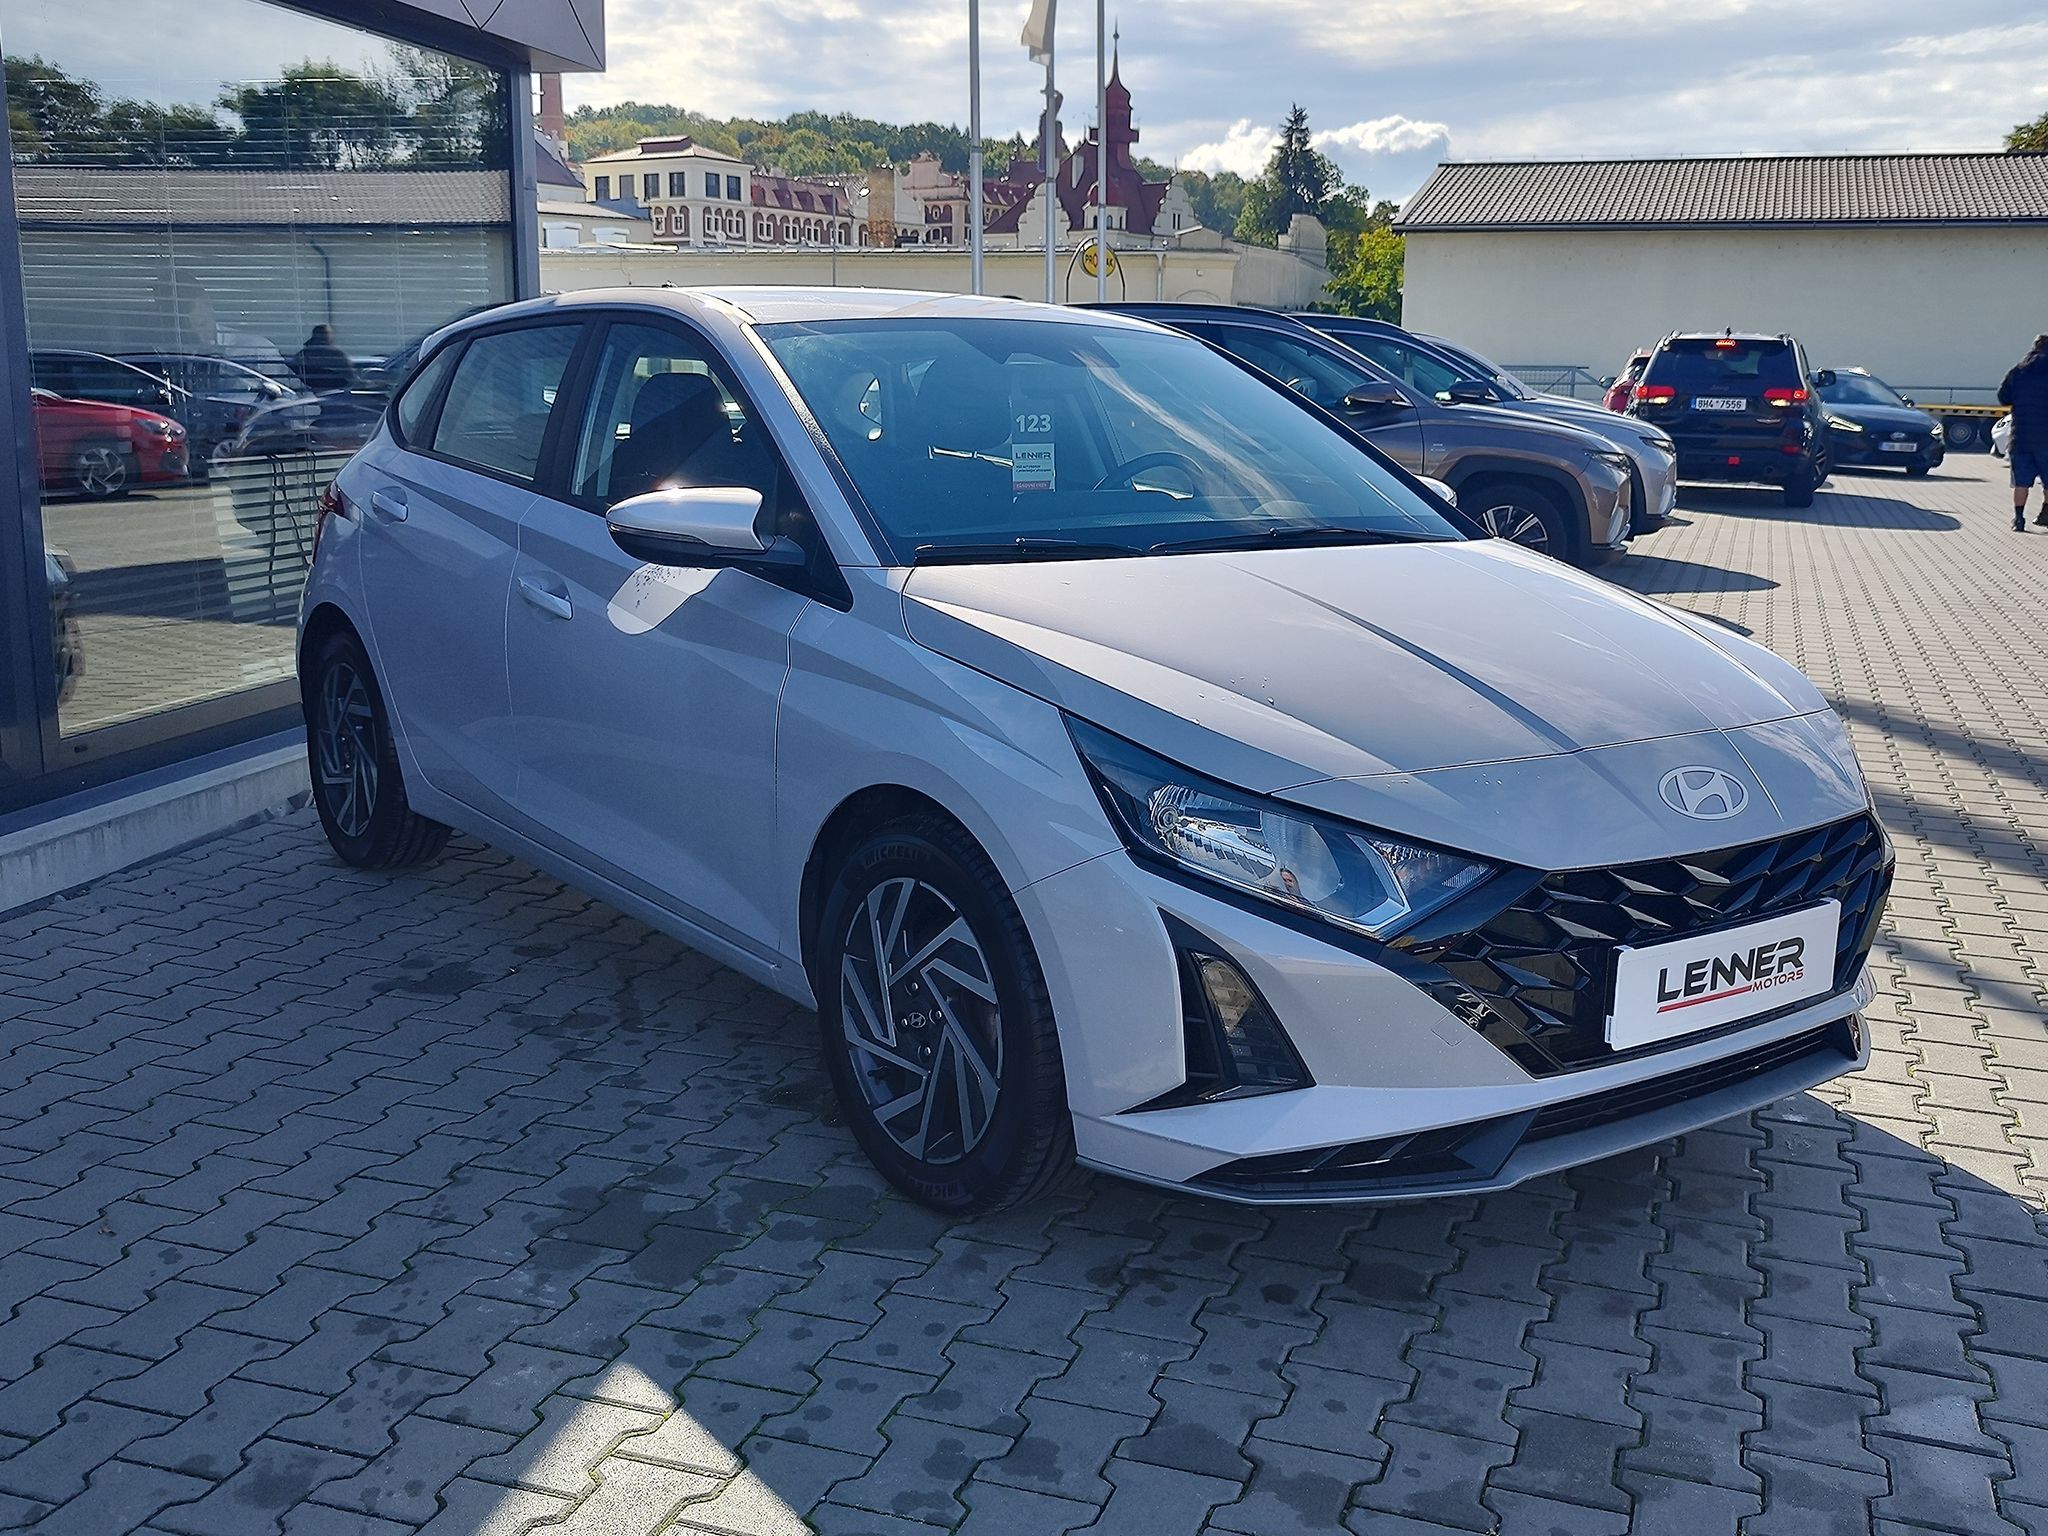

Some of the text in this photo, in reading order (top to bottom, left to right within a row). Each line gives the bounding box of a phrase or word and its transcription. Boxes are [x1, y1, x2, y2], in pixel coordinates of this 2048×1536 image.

[1016, 414, 1052, 432] 123
[1015, 451, 1052, 460] LENNER
[1657, 936, 1806, 1003] LENNER
[1752, 967, 1805, 993] MOTORS
